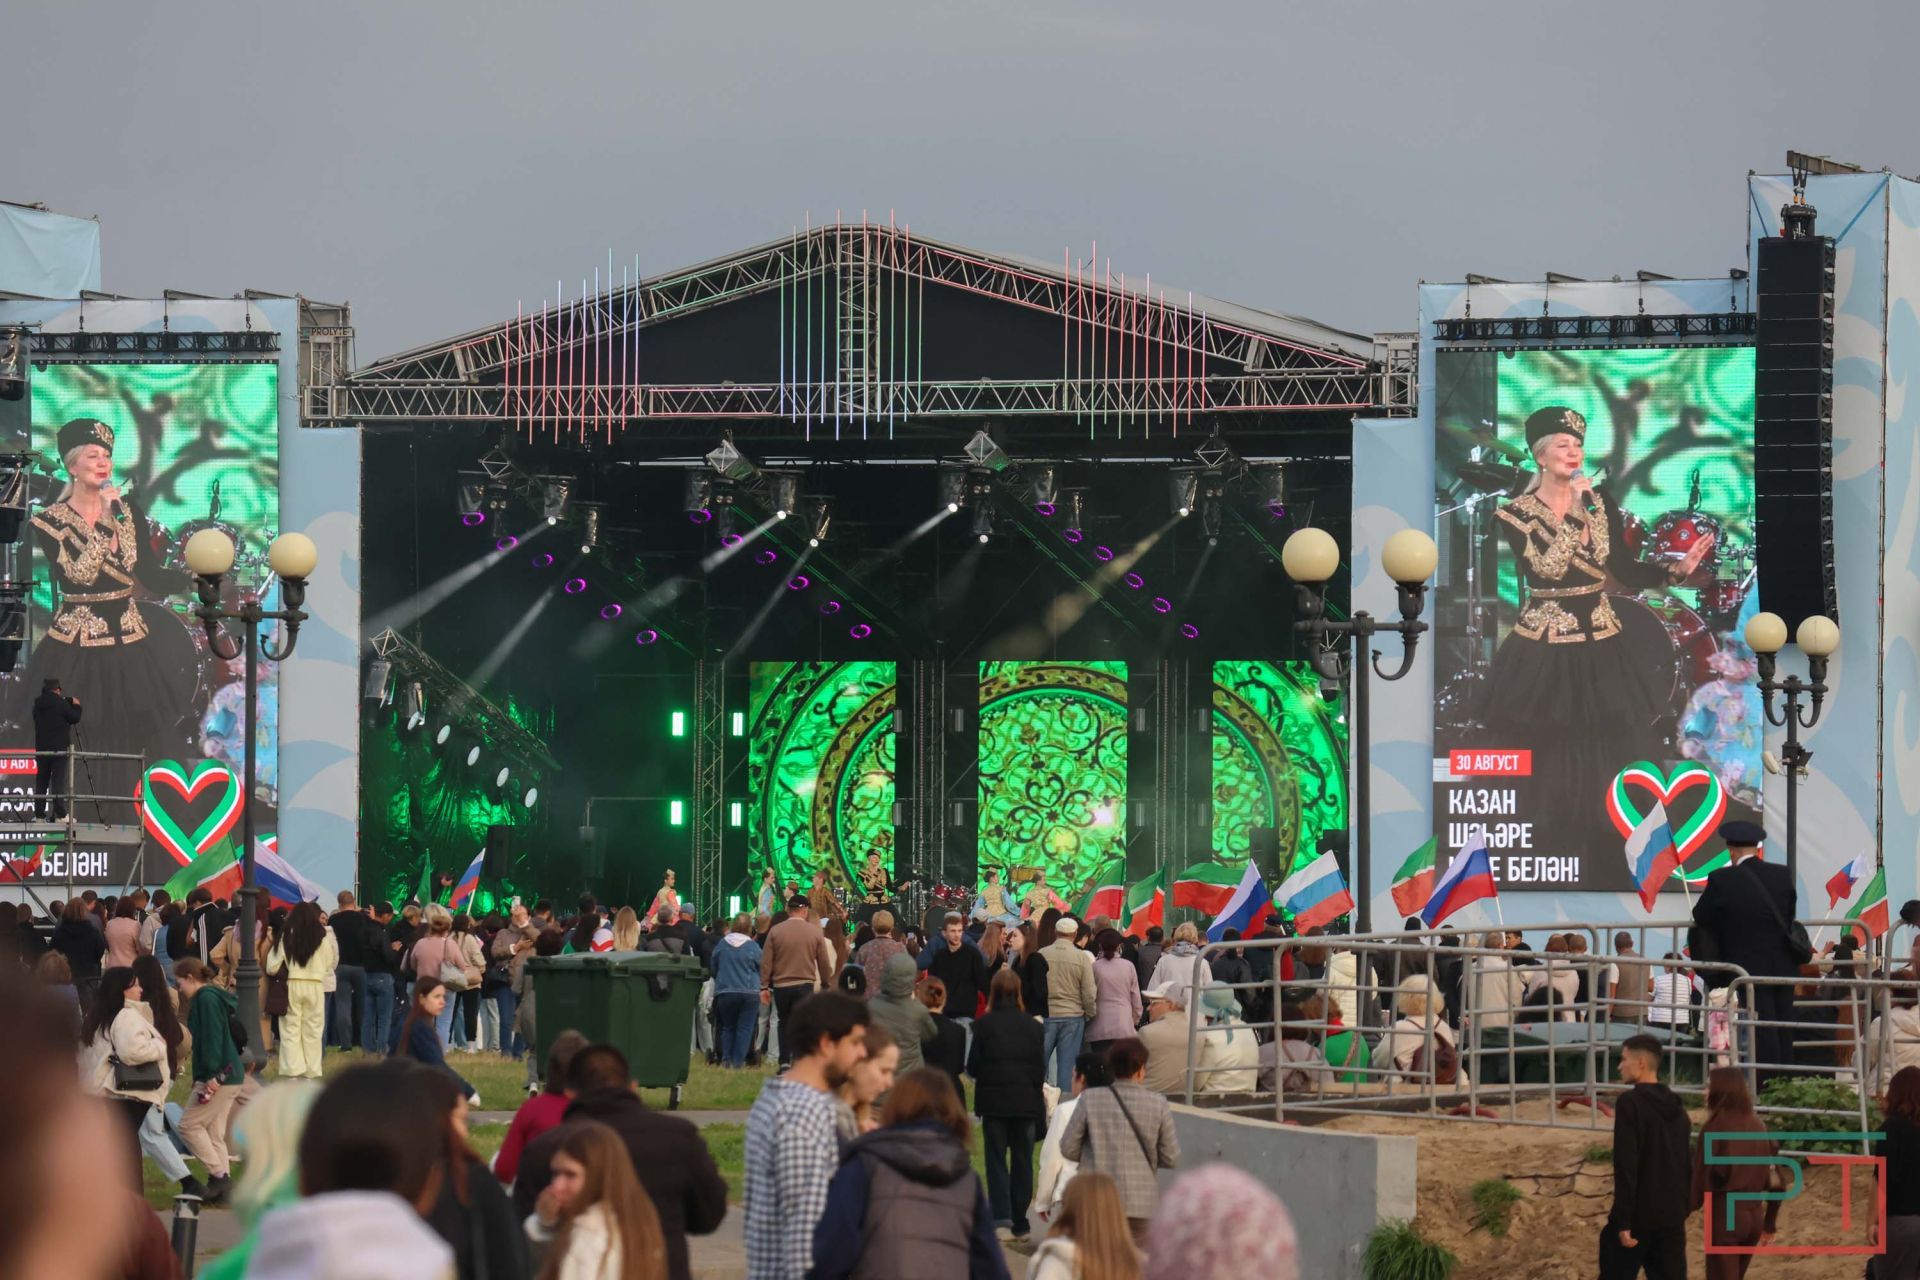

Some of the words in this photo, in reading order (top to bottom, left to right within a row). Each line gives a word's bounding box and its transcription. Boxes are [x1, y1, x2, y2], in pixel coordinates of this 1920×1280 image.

[311, 327, 348, 336] PROLYTE
[1456, 754, 1472, 771] 30
[1474, 754, 1519, 771] АВГУСТ
[1449, 789, 1516, 815] КАЗАН
[1507, 856, 1580, 882] БЕЛӘН!
